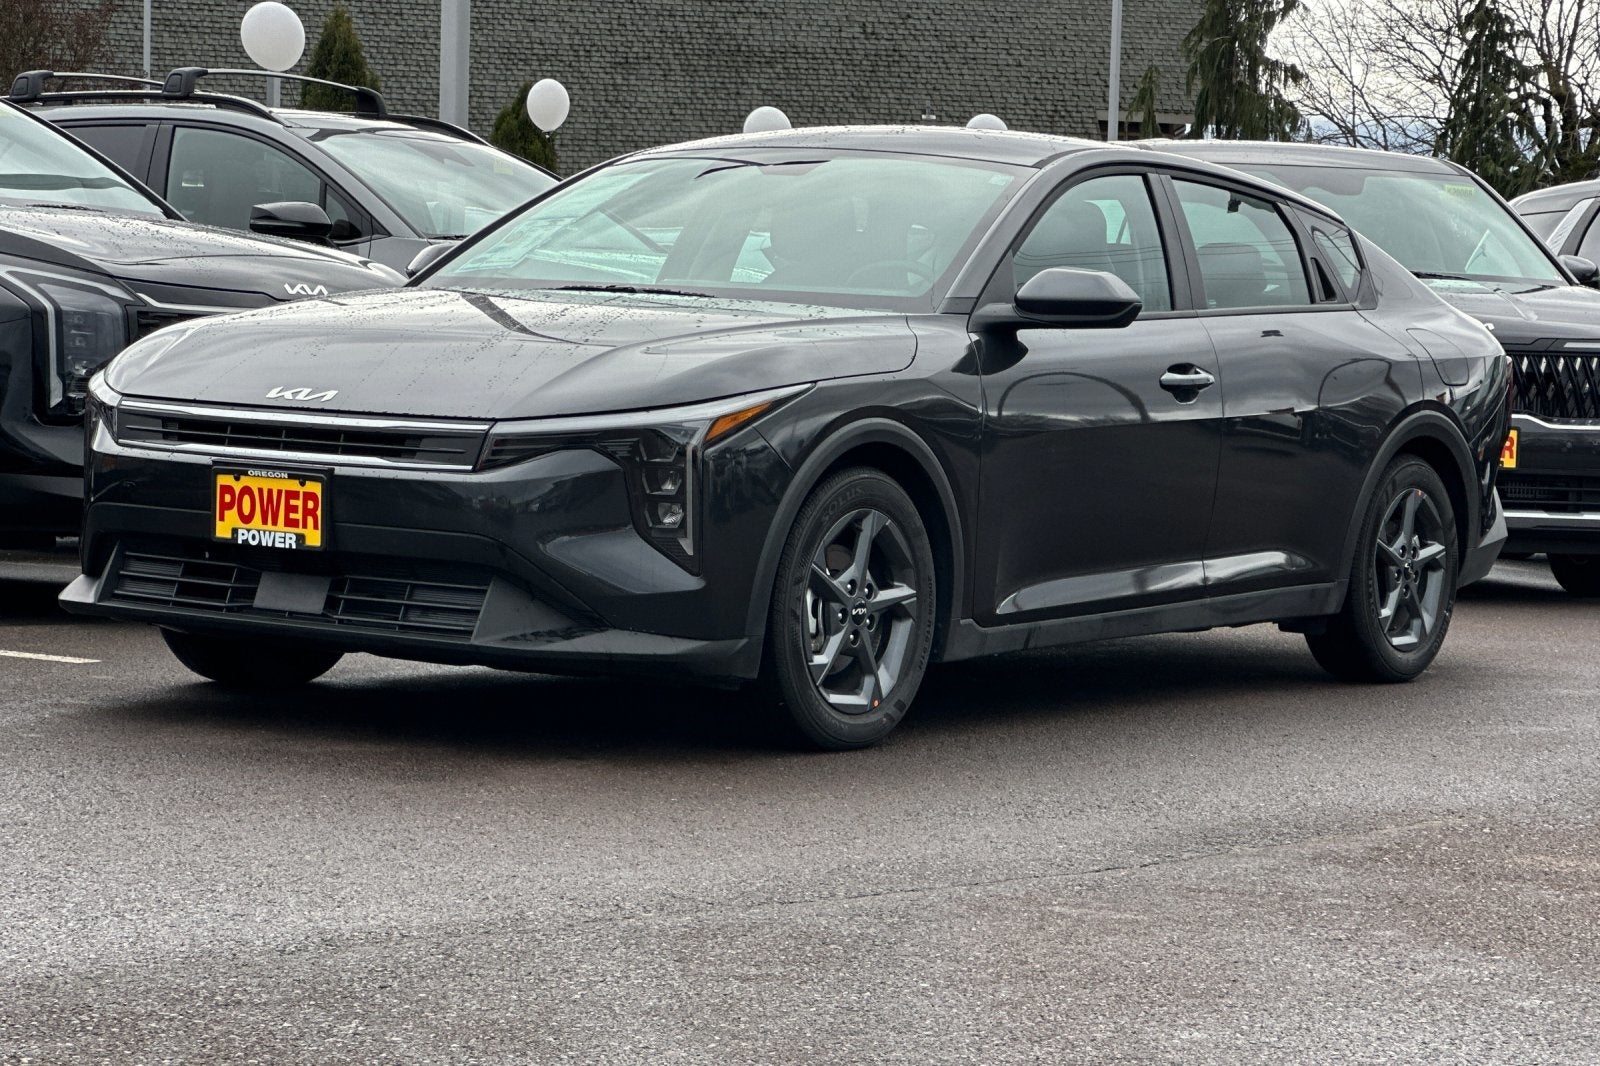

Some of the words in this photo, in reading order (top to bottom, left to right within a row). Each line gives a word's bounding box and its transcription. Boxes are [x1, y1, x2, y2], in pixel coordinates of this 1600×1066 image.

[284, 283, 328, 295] KIA
[266, 386, 338, 402] KIA
[248, 470, 288, 479] OREGON
[218, 484, 320, 531] POWER
[237, 529, 297, 549] POWER
